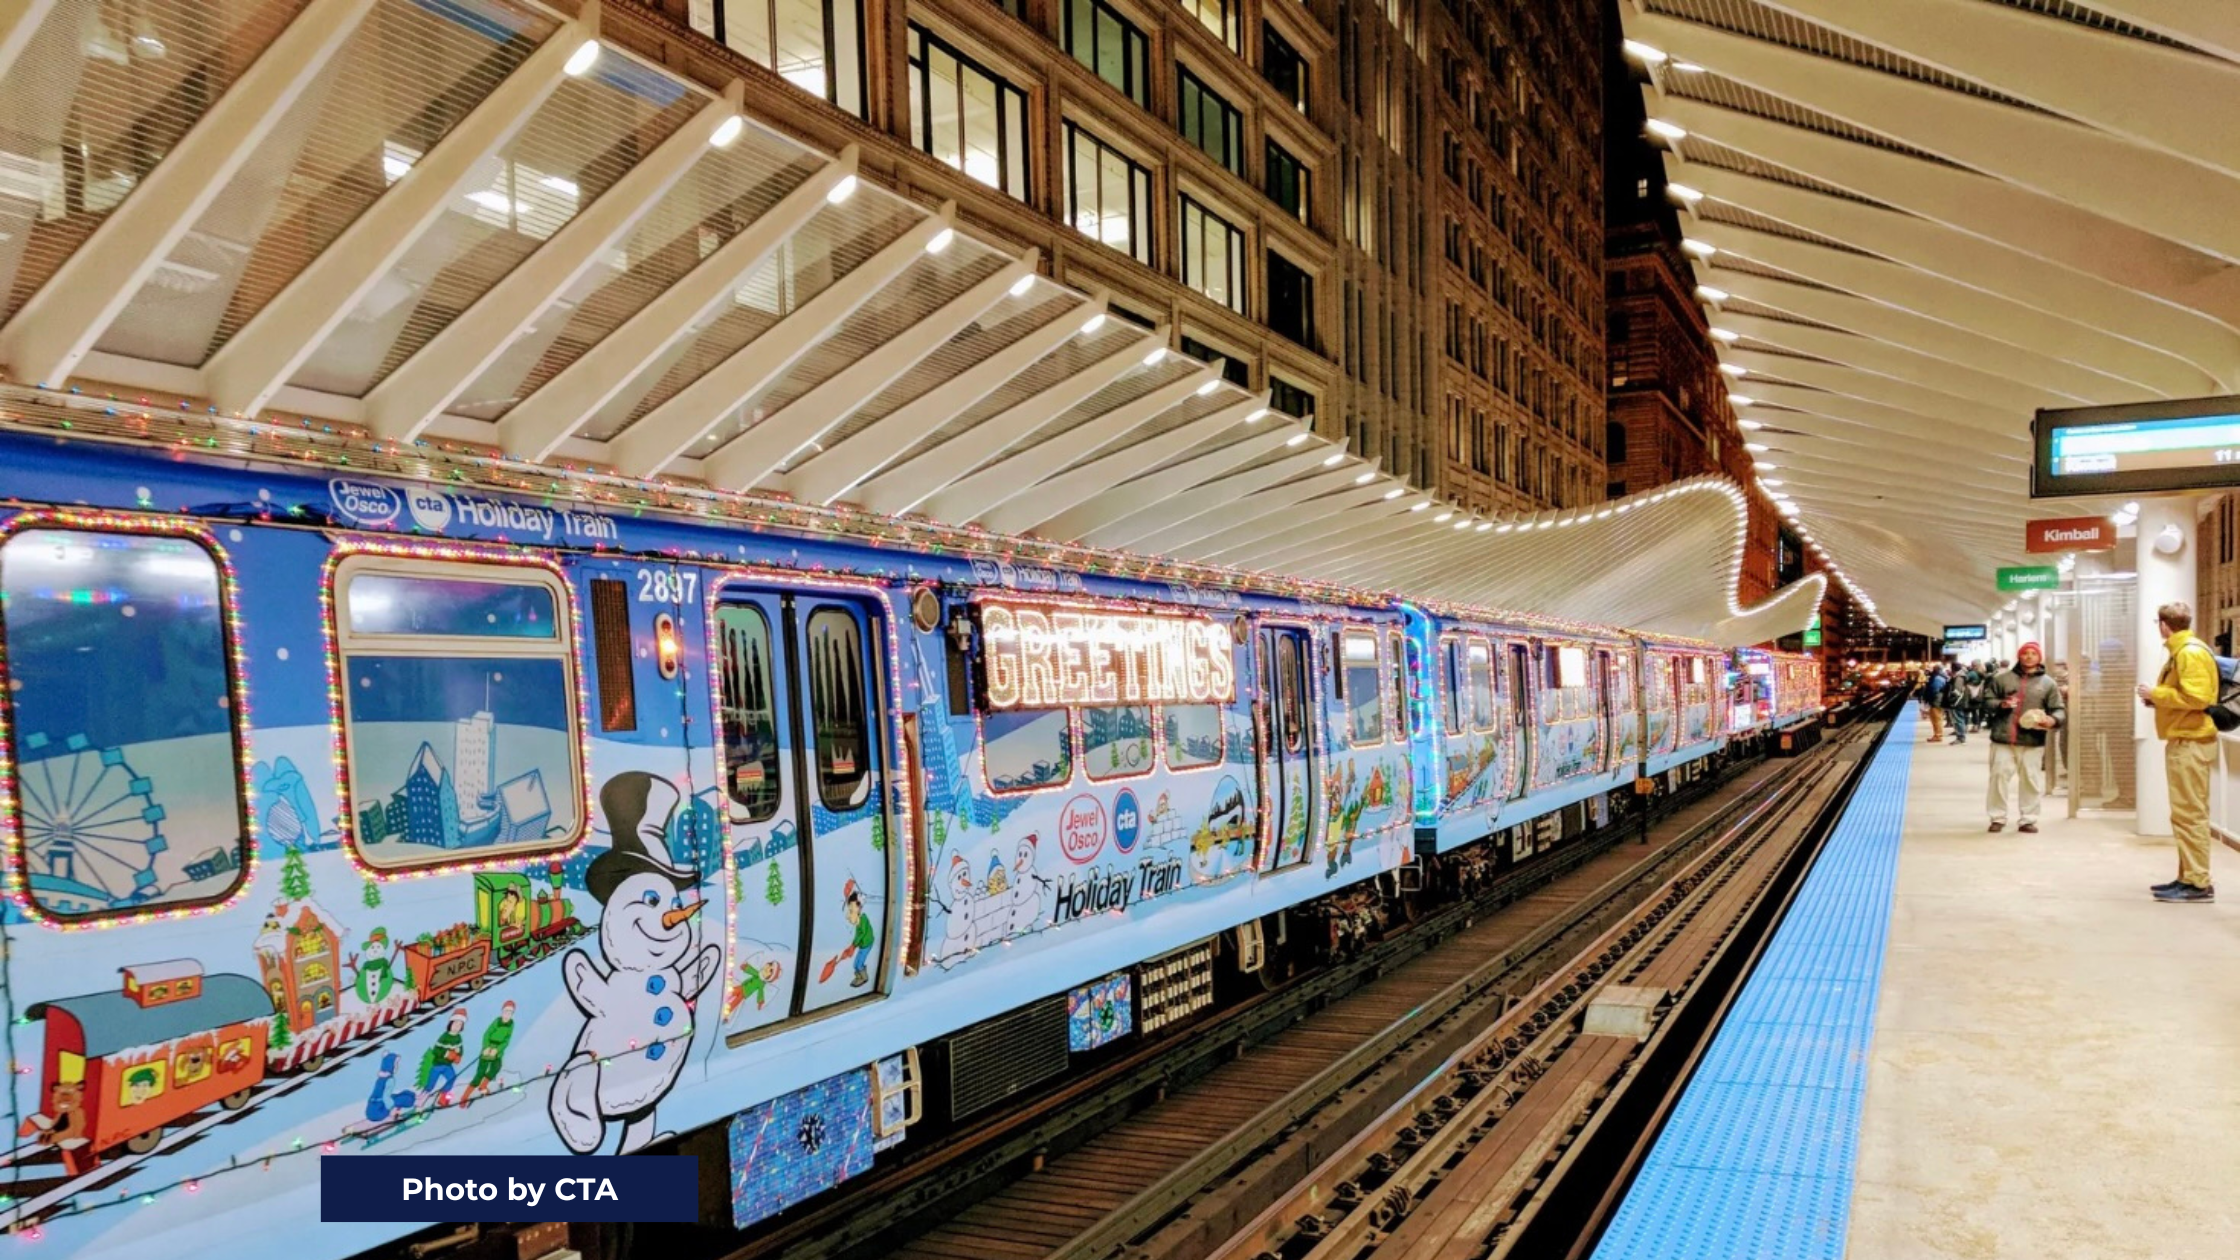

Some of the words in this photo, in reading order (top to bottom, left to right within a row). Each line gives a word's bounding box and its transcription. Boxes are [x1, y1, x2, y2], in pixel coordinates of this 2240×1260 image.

[340, 481, 387, 500] Jewel
[345, 496, 388, 514] Osco
[416, 497, 443, 511] cta
[454, 495, 553, 540] Holiday
[563, 510, 618, 539] Train
[2044, 527, 2099, 542] Kimball
[637, 568, 697, 604] 2897
[981, 606, 1235, 707] GREETINGS
[1066, 806, 1099, 831] Jewel
[1117, 809, 1137, 831] cta
[1068, 832, 1099, 852] Osco
[1053, 864, 1136, 923] Holiday
[1139, 852, 1183, 899] Train
